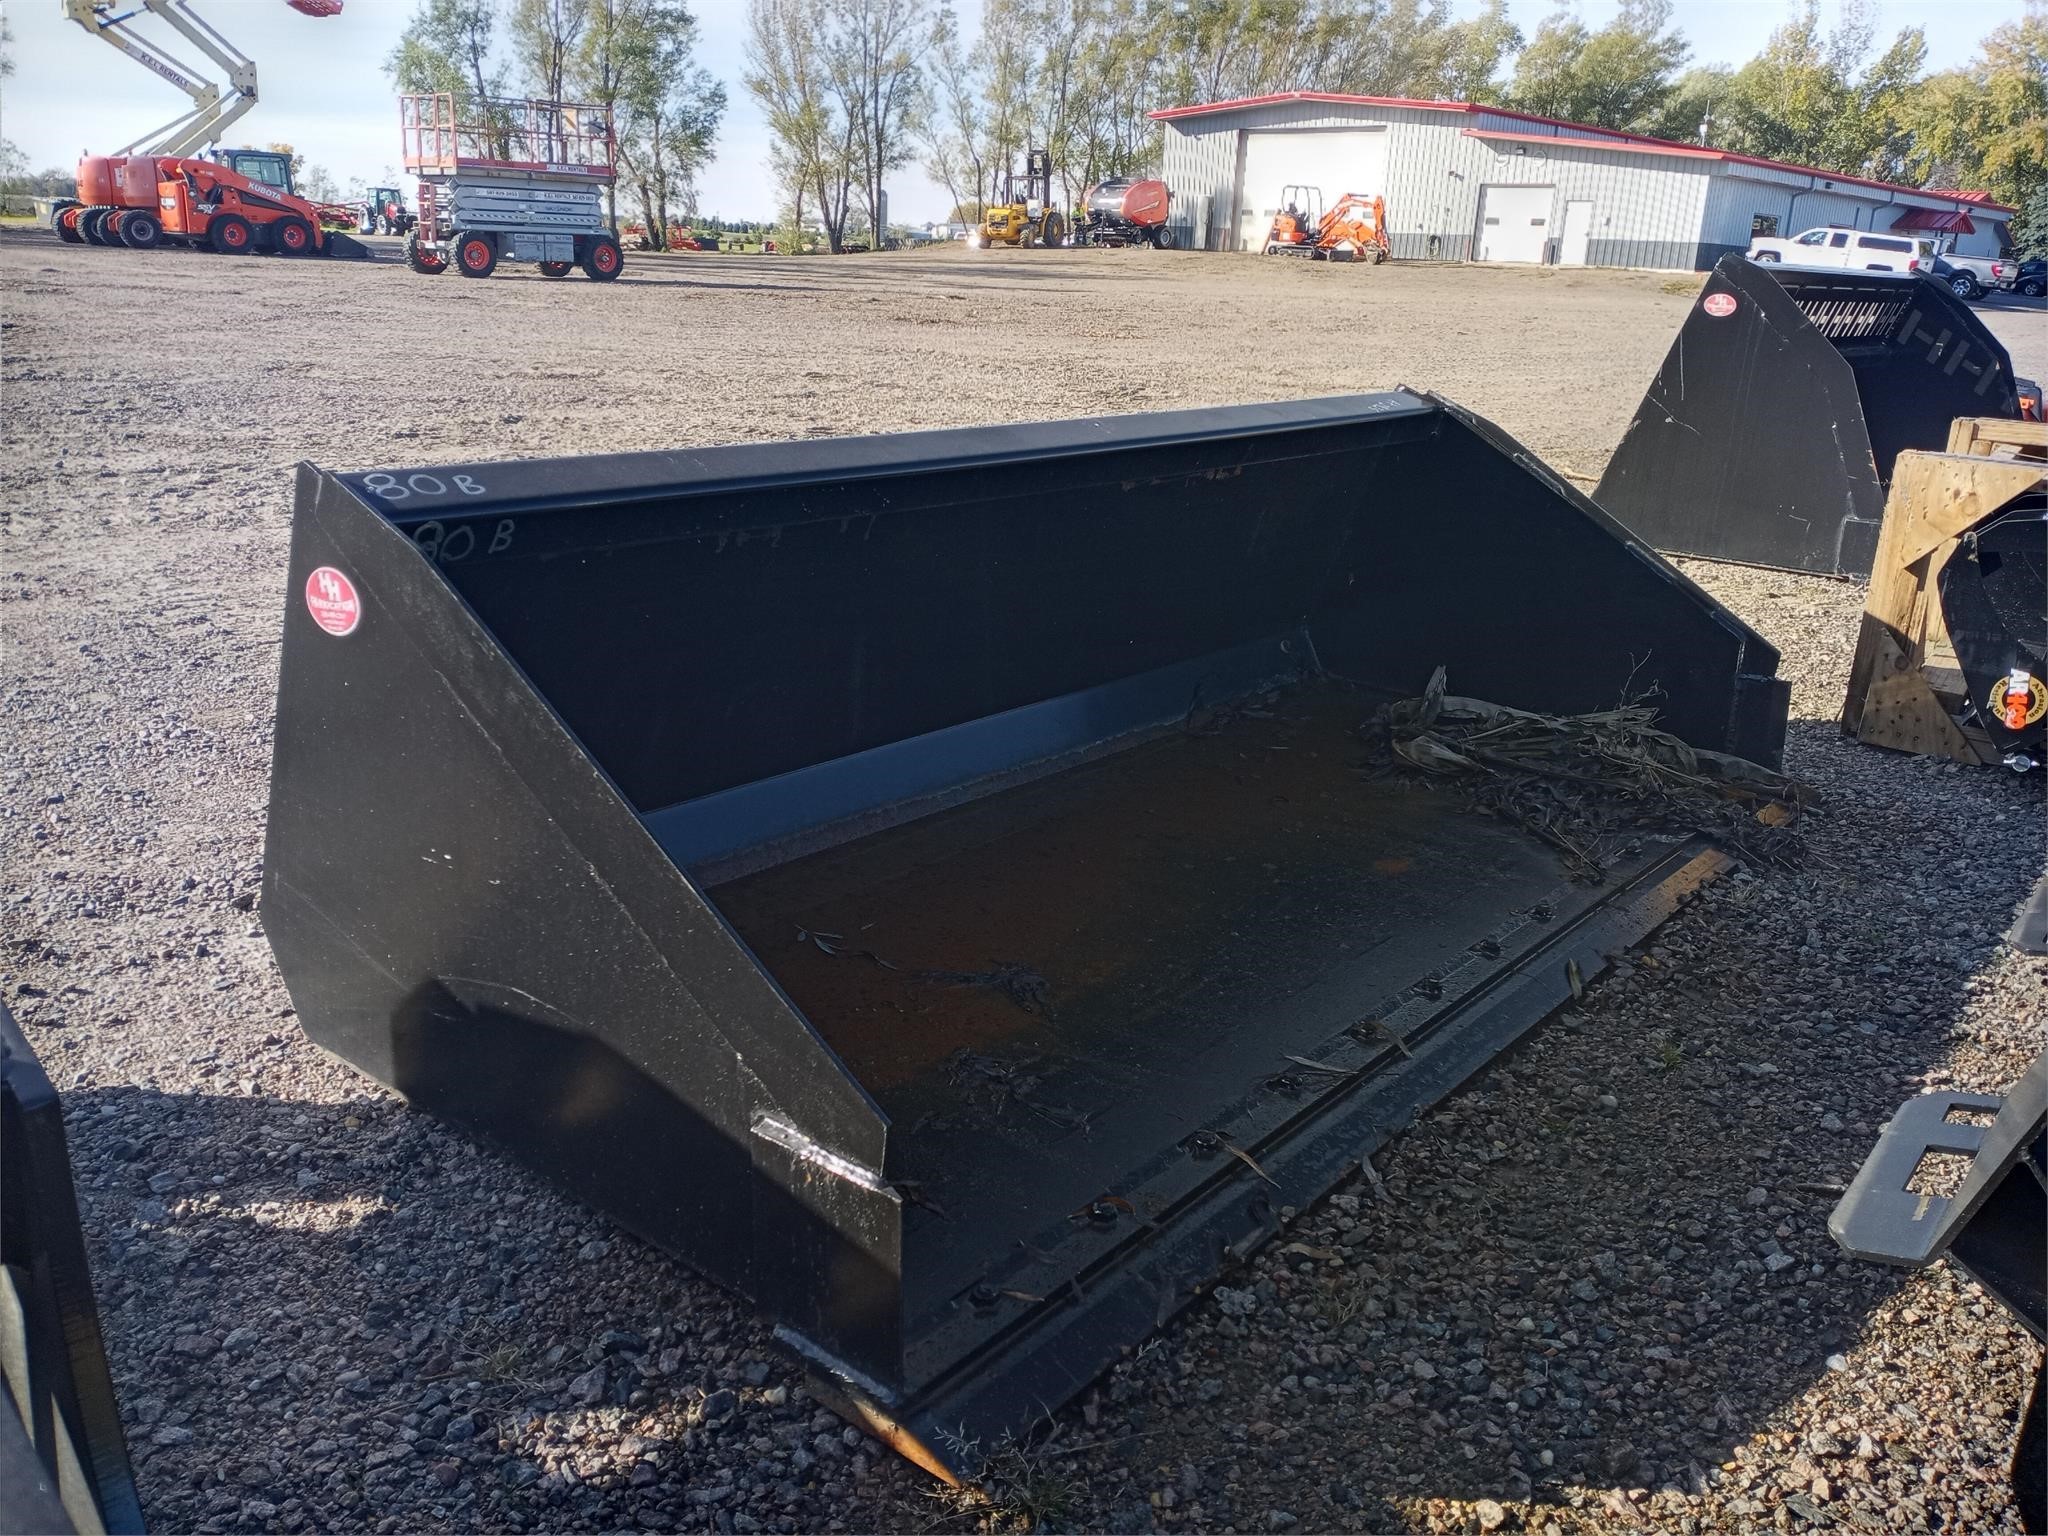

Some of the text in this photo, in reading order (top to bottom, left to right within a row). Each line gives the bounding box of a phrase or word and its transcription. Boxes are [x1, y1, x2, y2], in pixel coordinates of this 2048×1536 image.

[158, 64, 188, 87] RENTALS
[247, 181, 281, 200] KUBOTA
[362, 472, 486, 500] 80 B
[487, 518, 515, 555] B
[2028, 682, 2045, 718] Abrasion
